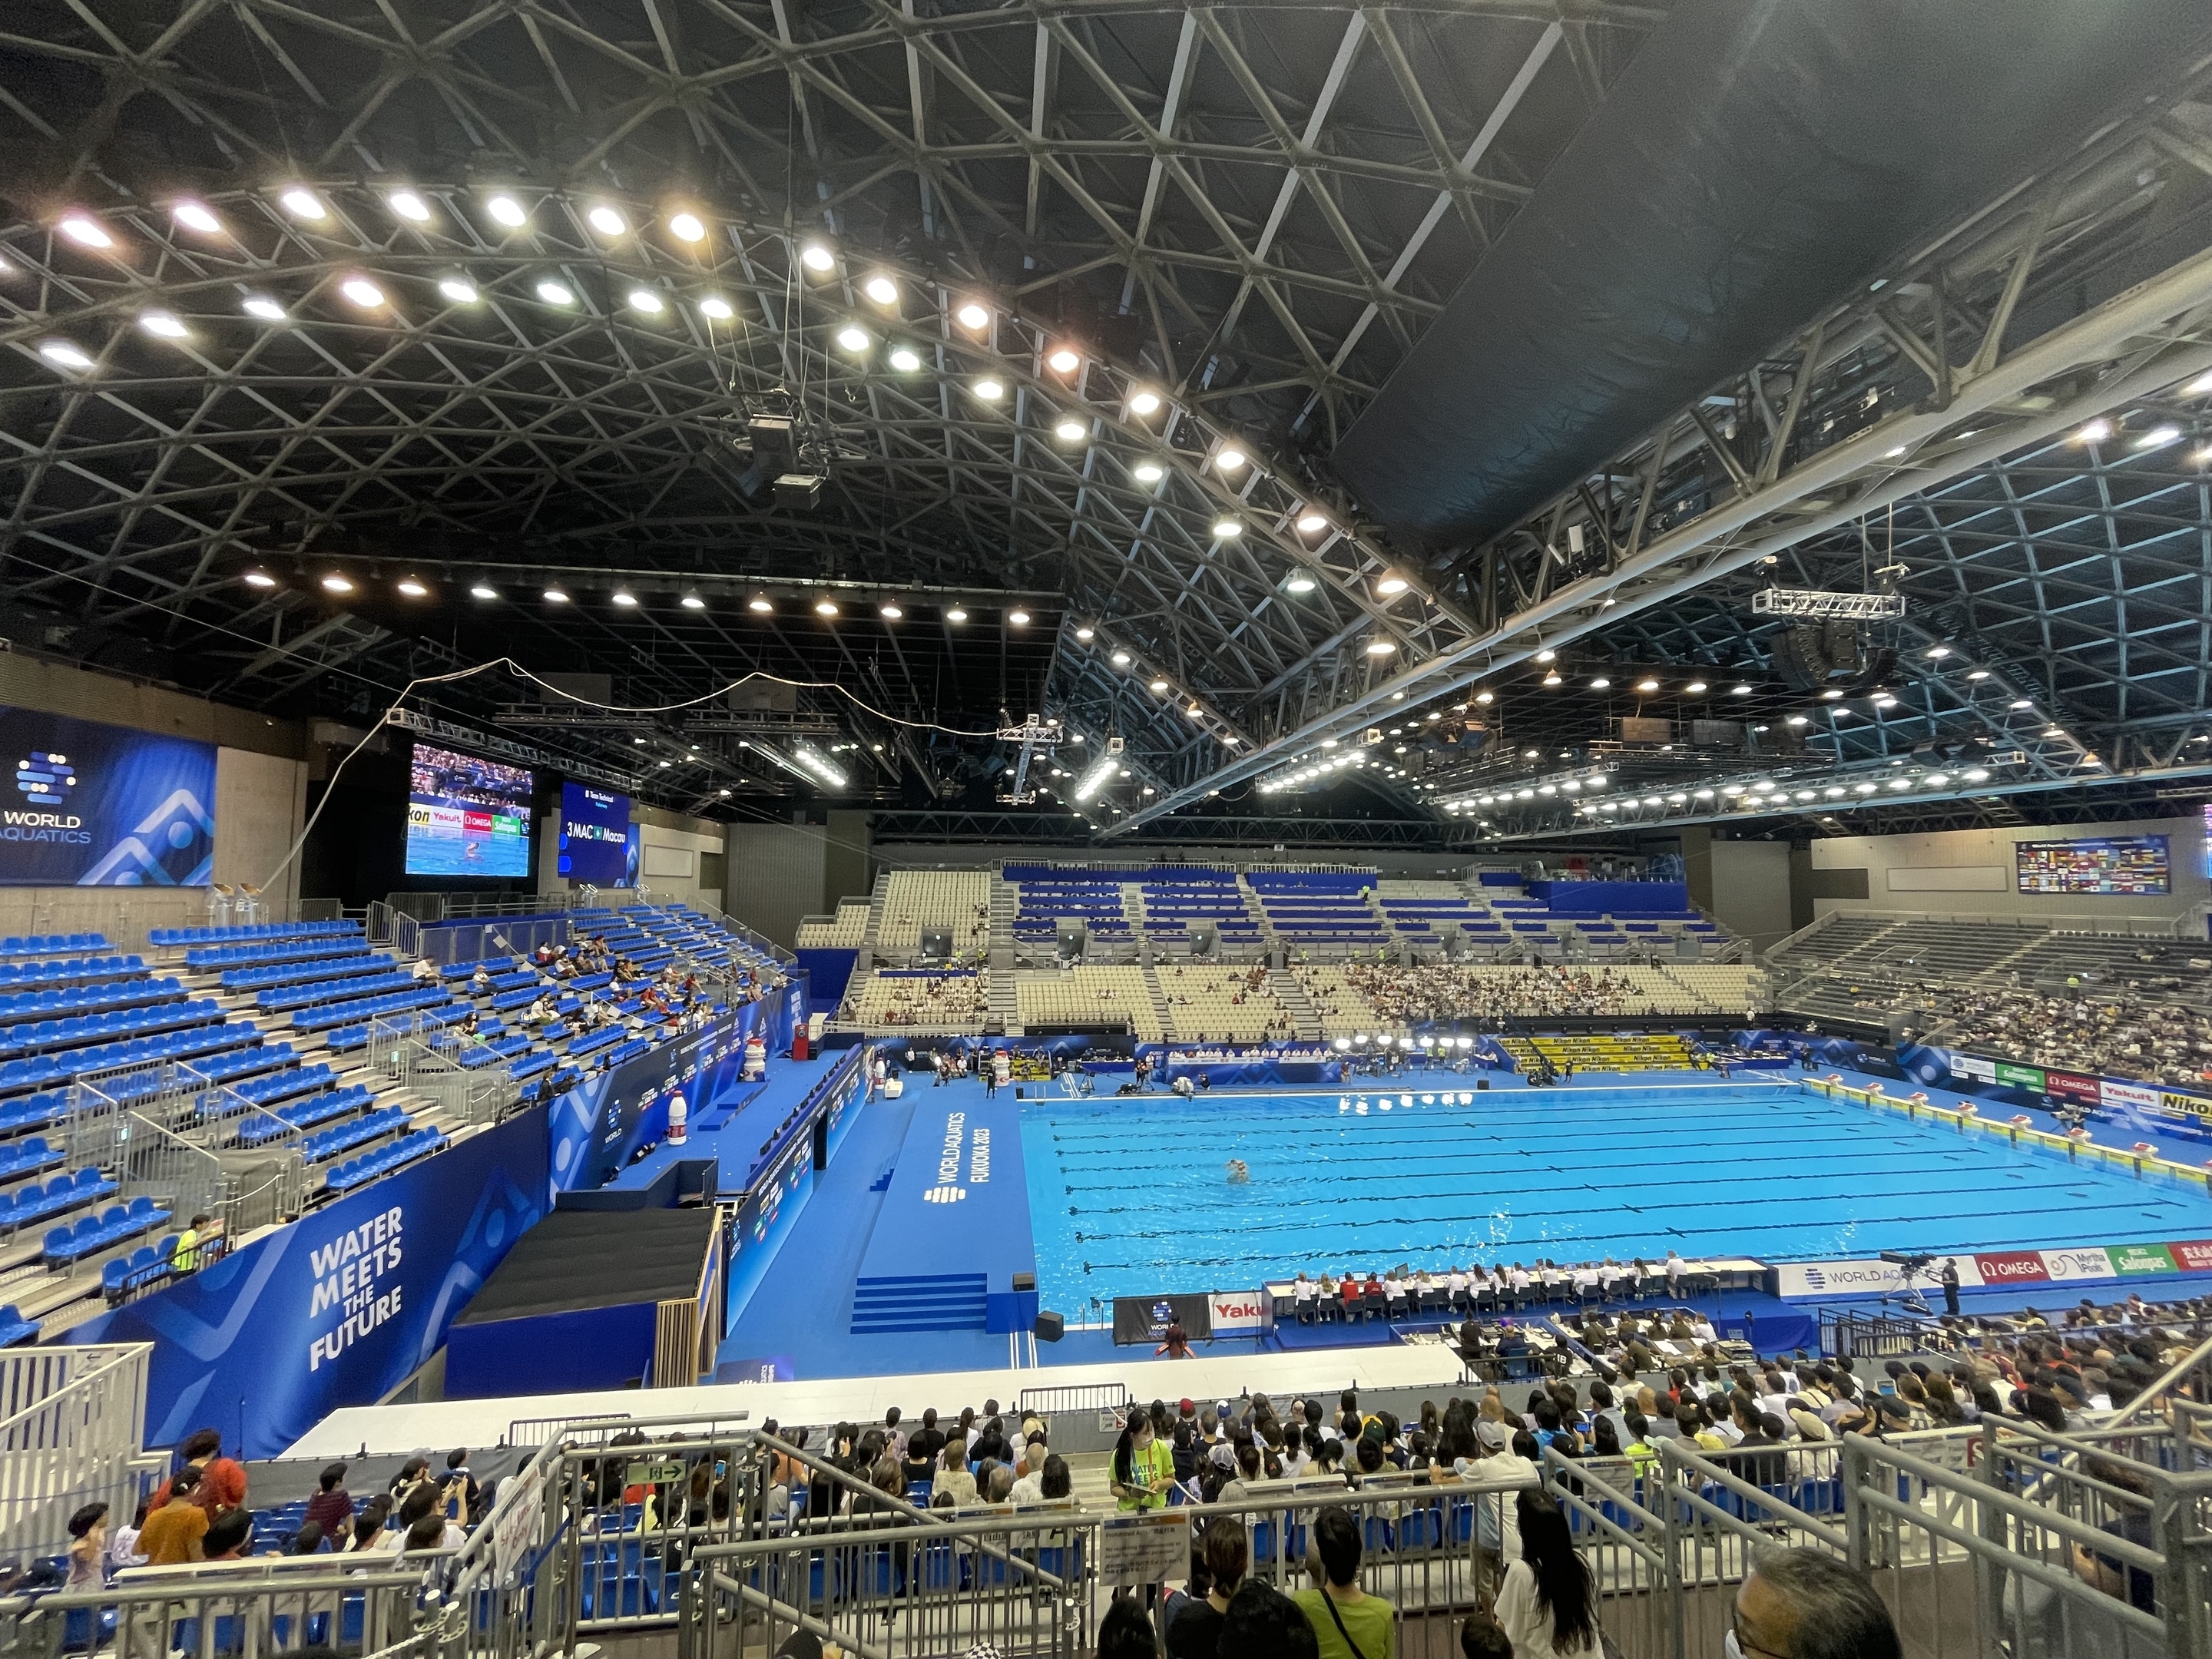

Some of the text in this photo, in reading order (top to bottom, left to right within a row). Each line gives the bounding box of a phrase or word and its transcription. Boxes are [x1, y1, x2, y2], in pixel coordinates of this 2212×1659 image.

[3, 810, 81, 829] WORLD
[433, 811, 462, 823] Yakult
[472, 816, 492, 827] OMEGA
[602, 827, 626, 843] Macau
[2061, 1079, 2097, 1092] OMEGA
[2104, 1087, 2155, 1102] Yakult
[2163, 1094, 2212, 1116] Niko
[604, 1127, 623, 1144] WORLD
[937, 1111, 965, 1184] WORLD AQUATICS
[970, 1128, 990, 1183] FUKUOKA 2023
[310, 1206, 404, 1280] WATER
[2075, 1253, 2106, 1264] Myrtha
[1998, 1260, 2044, 1276] OMEGA
[2079, 1263, 2104, 1273] Pools
[309, 1236, 402, 1319] MEETS
[1828, 1270, 1881, 1283] WORLD
[343, 1283, 375, 1318] THE
[310, 1284, 402, 1373] FUTURE
[1132, 1463, 1158, 1474] ATR
